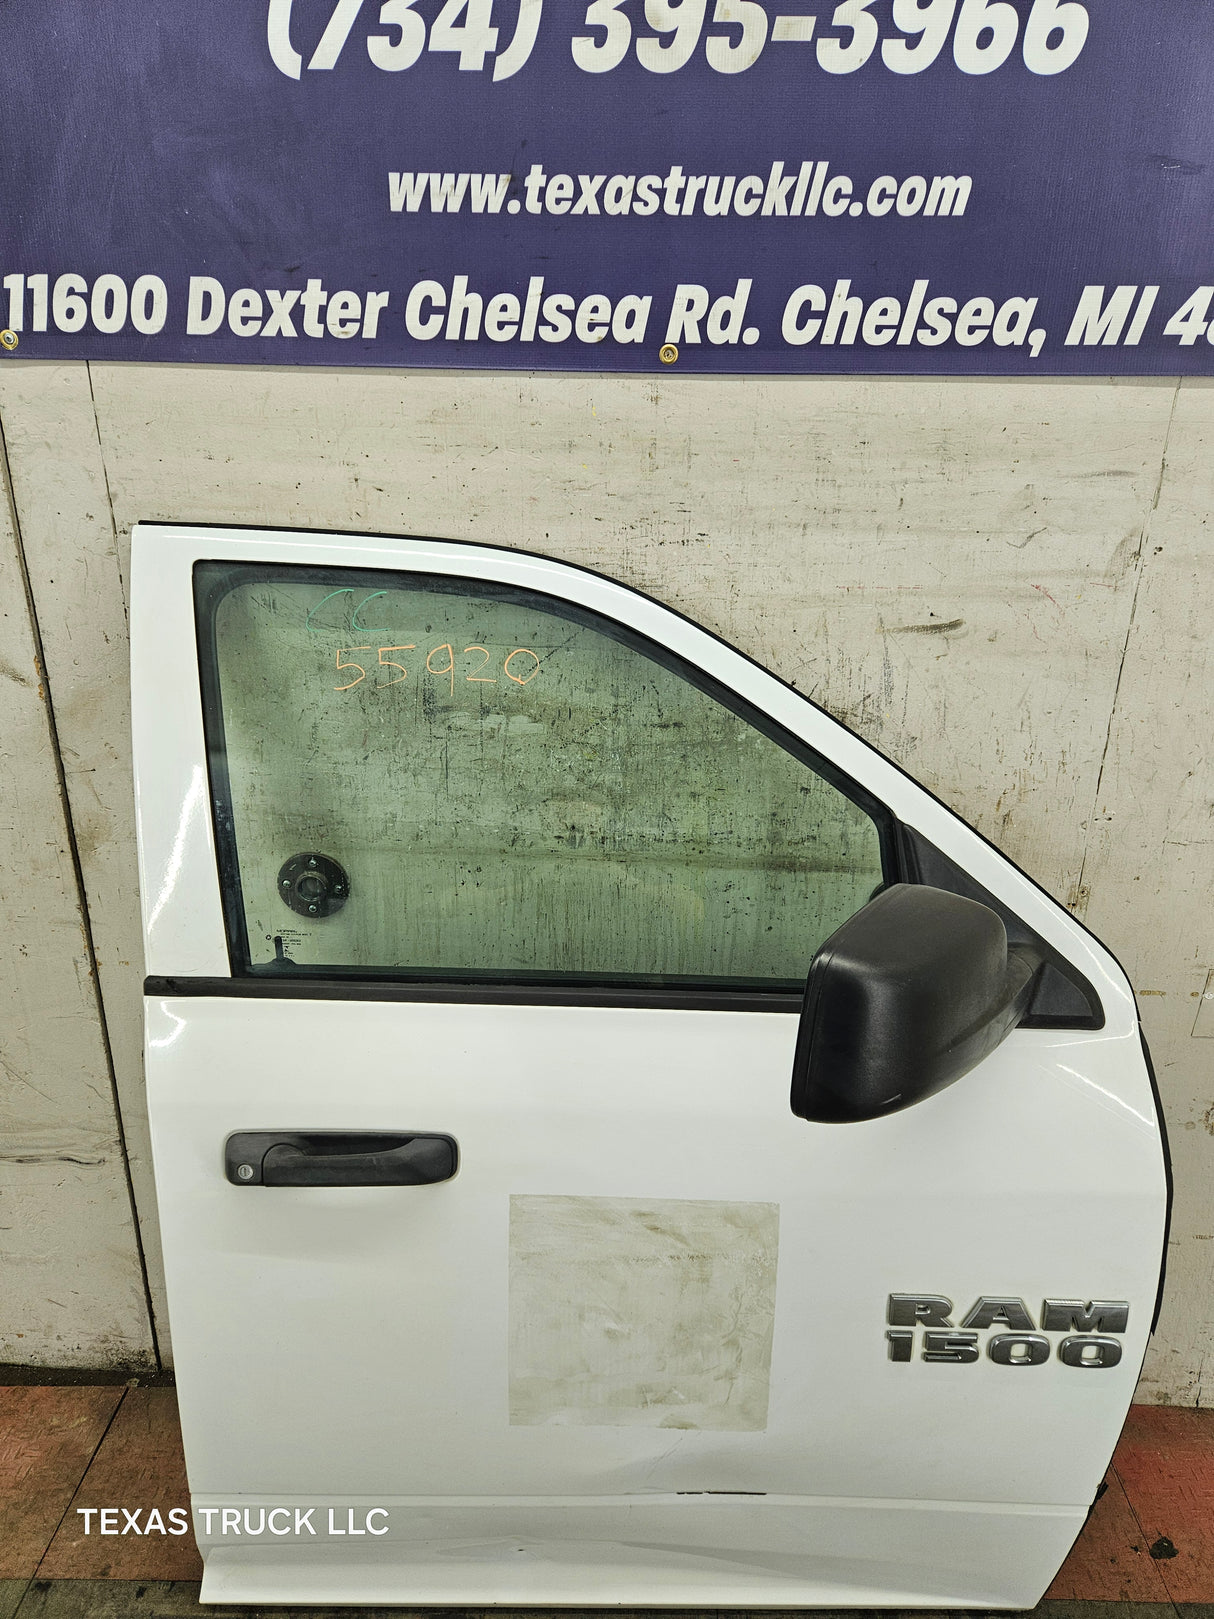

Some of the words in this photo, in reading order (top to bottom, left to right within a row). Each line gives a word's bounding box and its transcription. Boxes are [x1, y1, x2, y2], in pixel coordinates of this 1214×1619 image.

[267, 0, 543, 82] (734)
[571, 0, 1090, 76] 395-3966
[388, 161, 973, 217] www.texastruckllc.com
[3, 273, 168, 335] 11600
[186, 276, 390, 339] Dexter
[405, 275, 653, 344] Chelsea
[664, 278, 760, 345] Rd.
[781, 279, 1047, 358] Chelsea,
[1063, 285, 1161, 346] MI
[1162, 285, 1214, 346] 4
[333, 643, 541, 697] 55920
[888, 1292, 1129, 1334] RAM
[886, 1329, 1123, 1369] 1500
